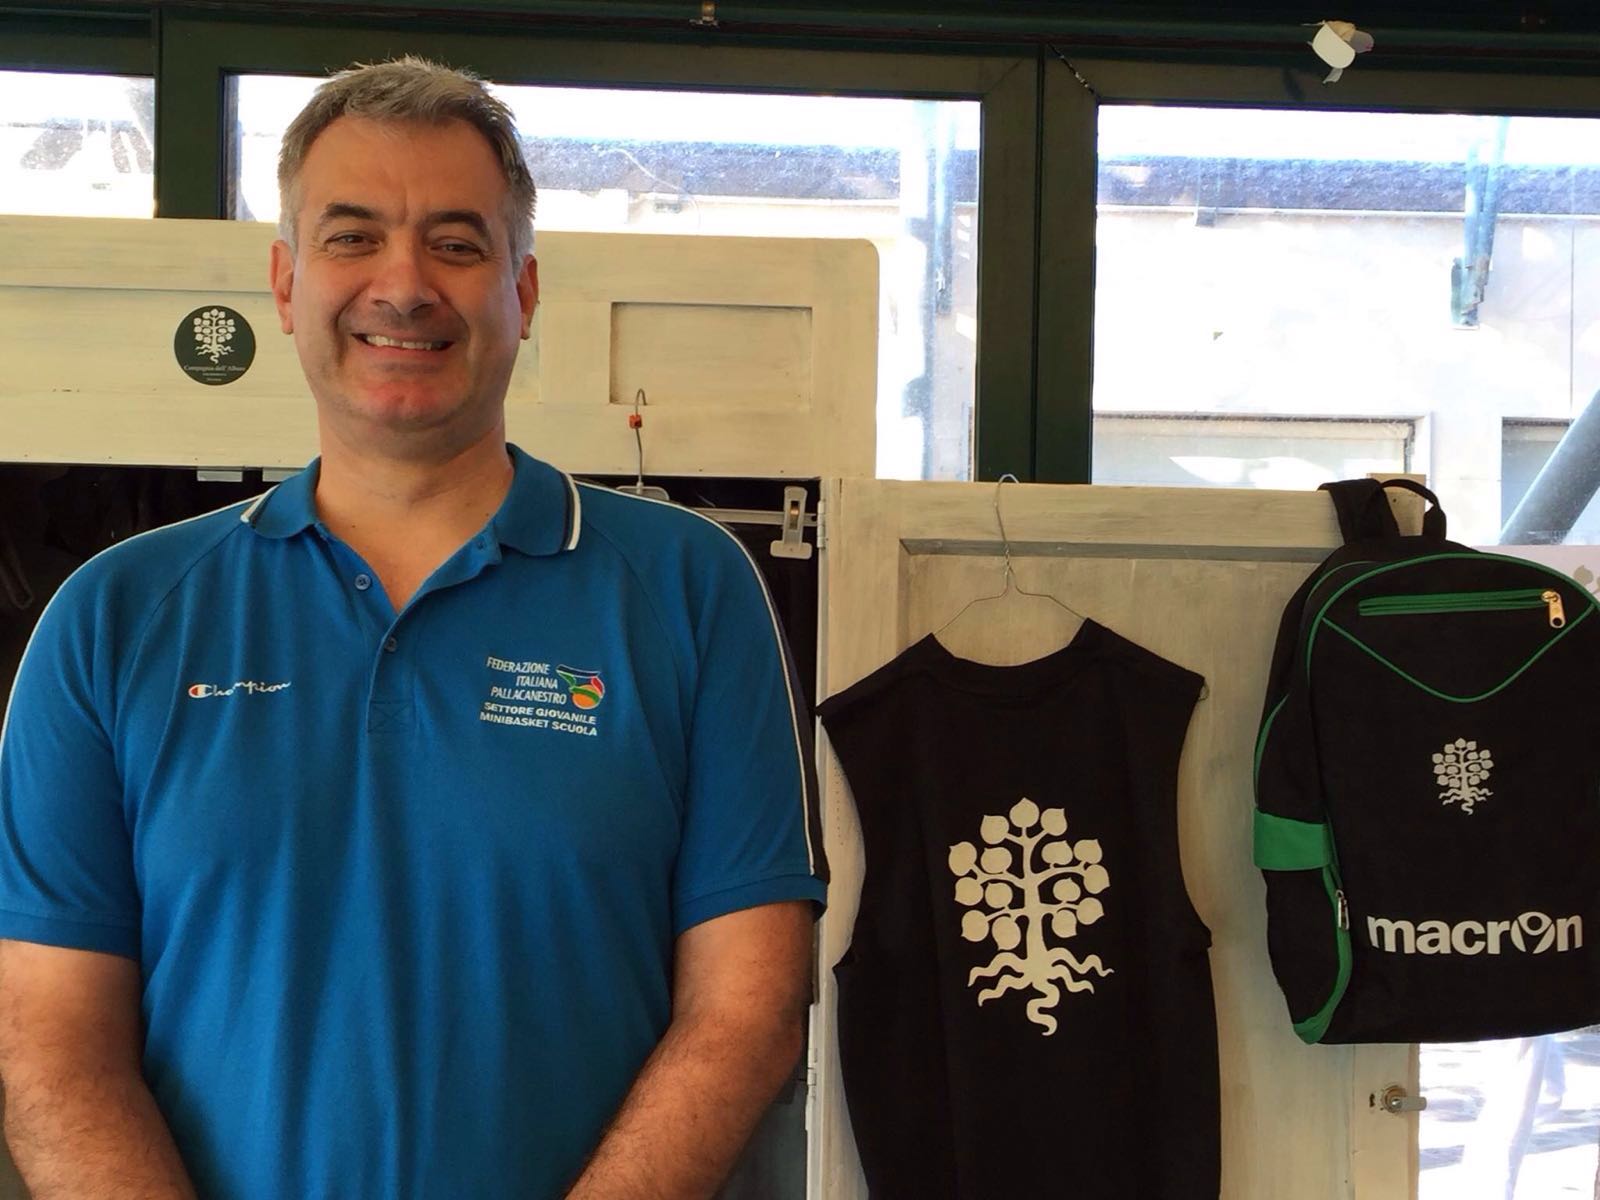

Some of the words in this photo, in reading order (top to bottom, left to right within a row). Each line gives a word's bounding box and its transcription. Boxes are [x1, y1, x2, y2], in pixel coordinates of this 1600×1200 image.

[486, 656, 551, 675] FEDERAZIONE
[188, 681, 292, 699] Champion
[516, 675, 558, 689] ITALIANA
[490, 686, 567, 705] PALLACANESTRO
[484, 702, 535, 716] SETTORE
[535, 707, 597, 725] GIOVANILE
[480, 711, 549, 729] MINIBASKET
[551, 720, 598, 736] SCUOLA
[1367, 911, 1583, 956] macron
